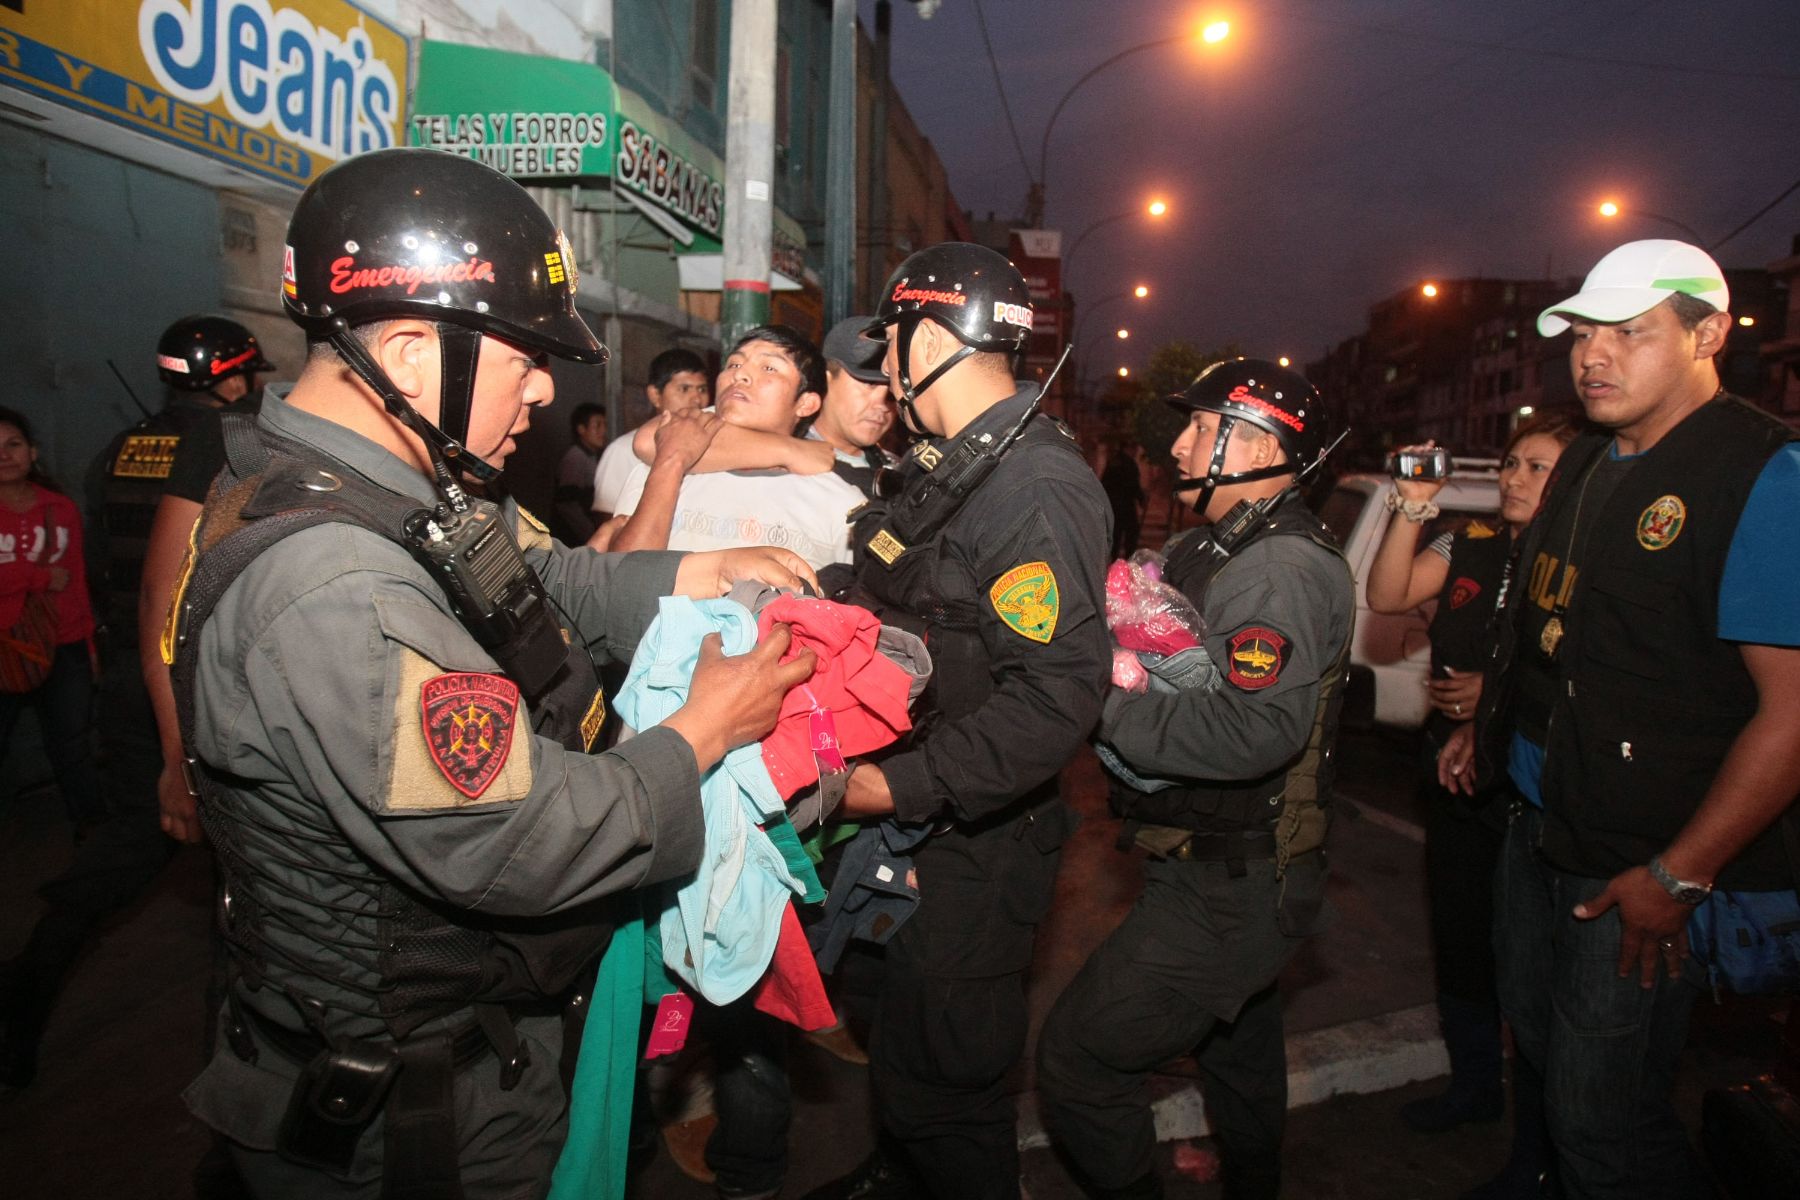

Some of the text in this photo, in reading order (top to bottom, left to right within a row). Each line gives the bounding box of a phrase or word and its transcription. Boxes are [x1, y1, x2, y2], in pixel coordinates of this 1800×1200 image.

[150, 0, 395, 158] Jean's
[55, 55, 92, 92] Y
[125, 83, 301, 176] MENOR
[414, 113, 606, 146] TELAS Y FORROS
[478, 147, 581, 174] MUEBLES
[619, 122, 723, 236] SABANAS
[330, 256, 496, 295] Emergencia
[892, 282, 968, 307] Emergencia
[1228, 385, 1305, 432] Emergencia
[428, 676, 515, 700] POLICIA NACIONAL
